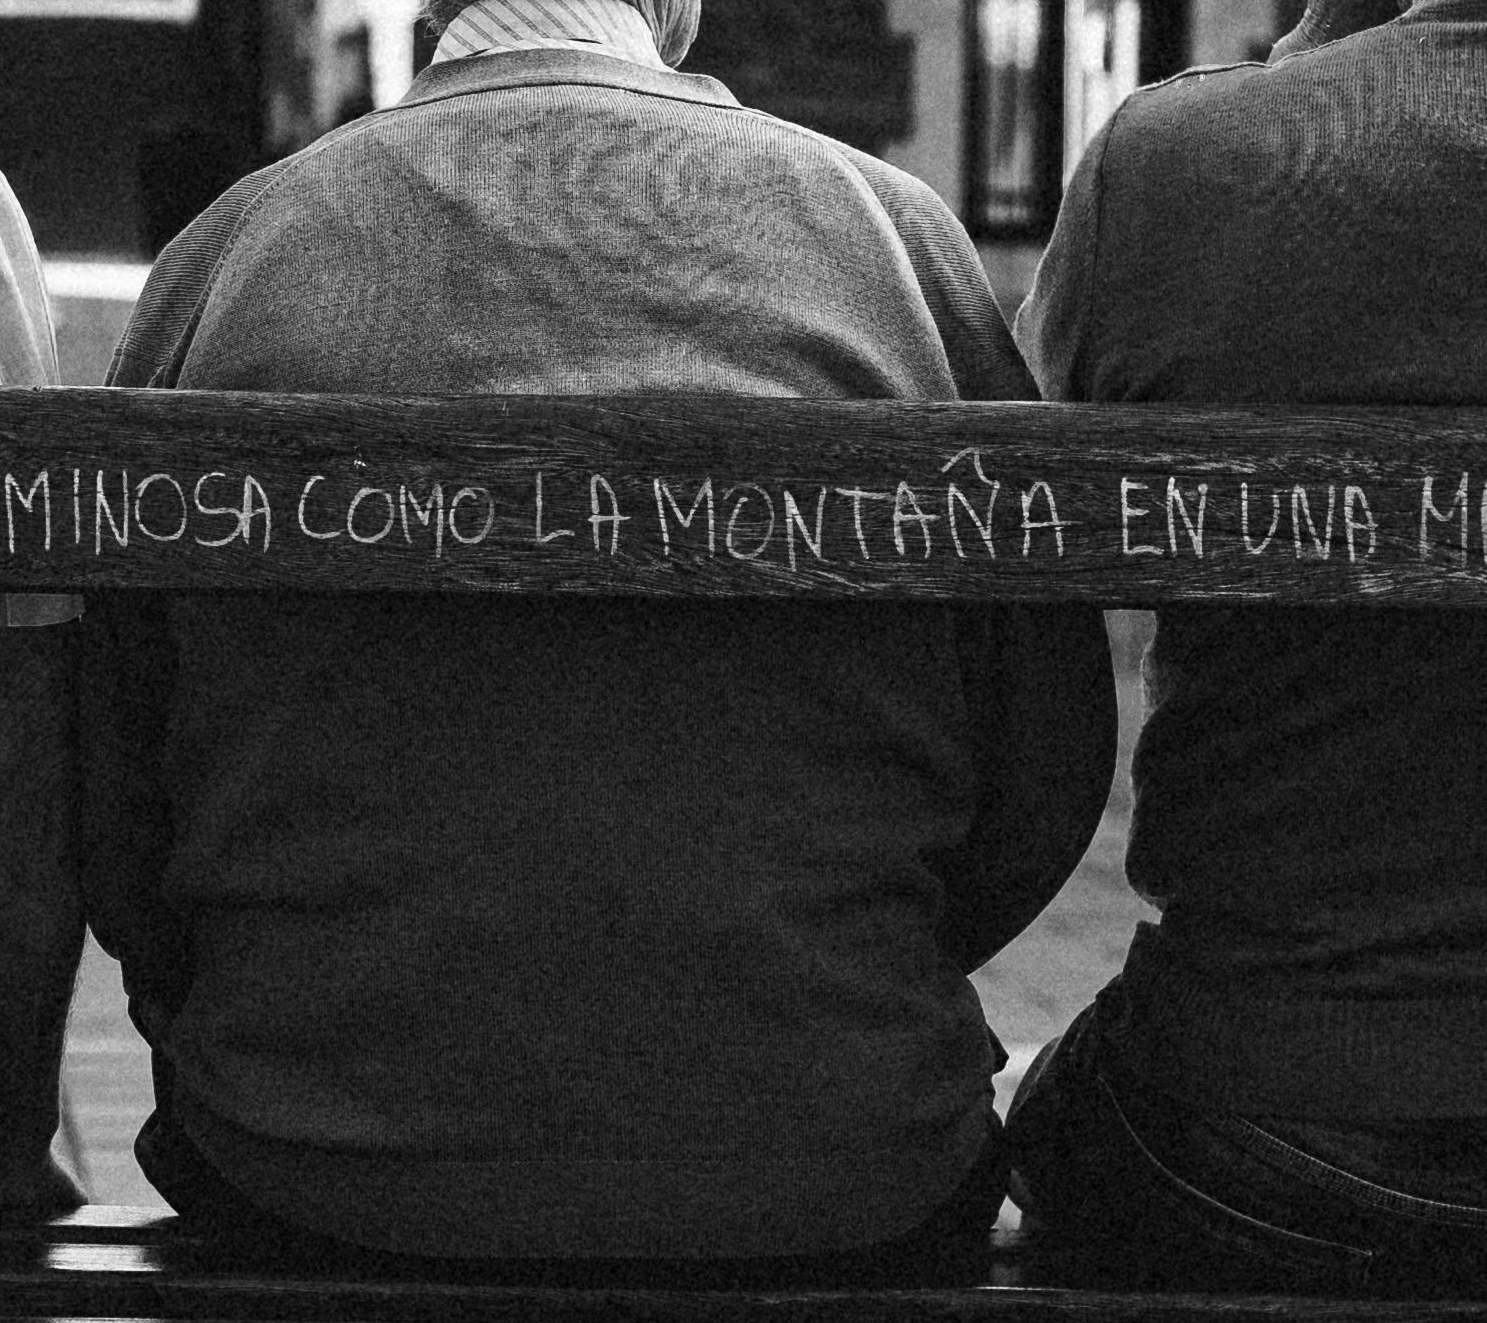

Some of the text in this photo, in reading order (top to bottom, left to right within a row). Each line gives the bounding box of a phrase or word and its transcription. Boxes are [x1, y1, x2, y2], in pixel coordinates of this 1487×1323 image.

[297, 475, 495, 559] COMO
[535, 472, 631, 557] LA
[653, 447, 1082, 573] MONTAÑA
[1121, 476, 1208, 559] EN
[1240, 481, 1379, 563] UNA
